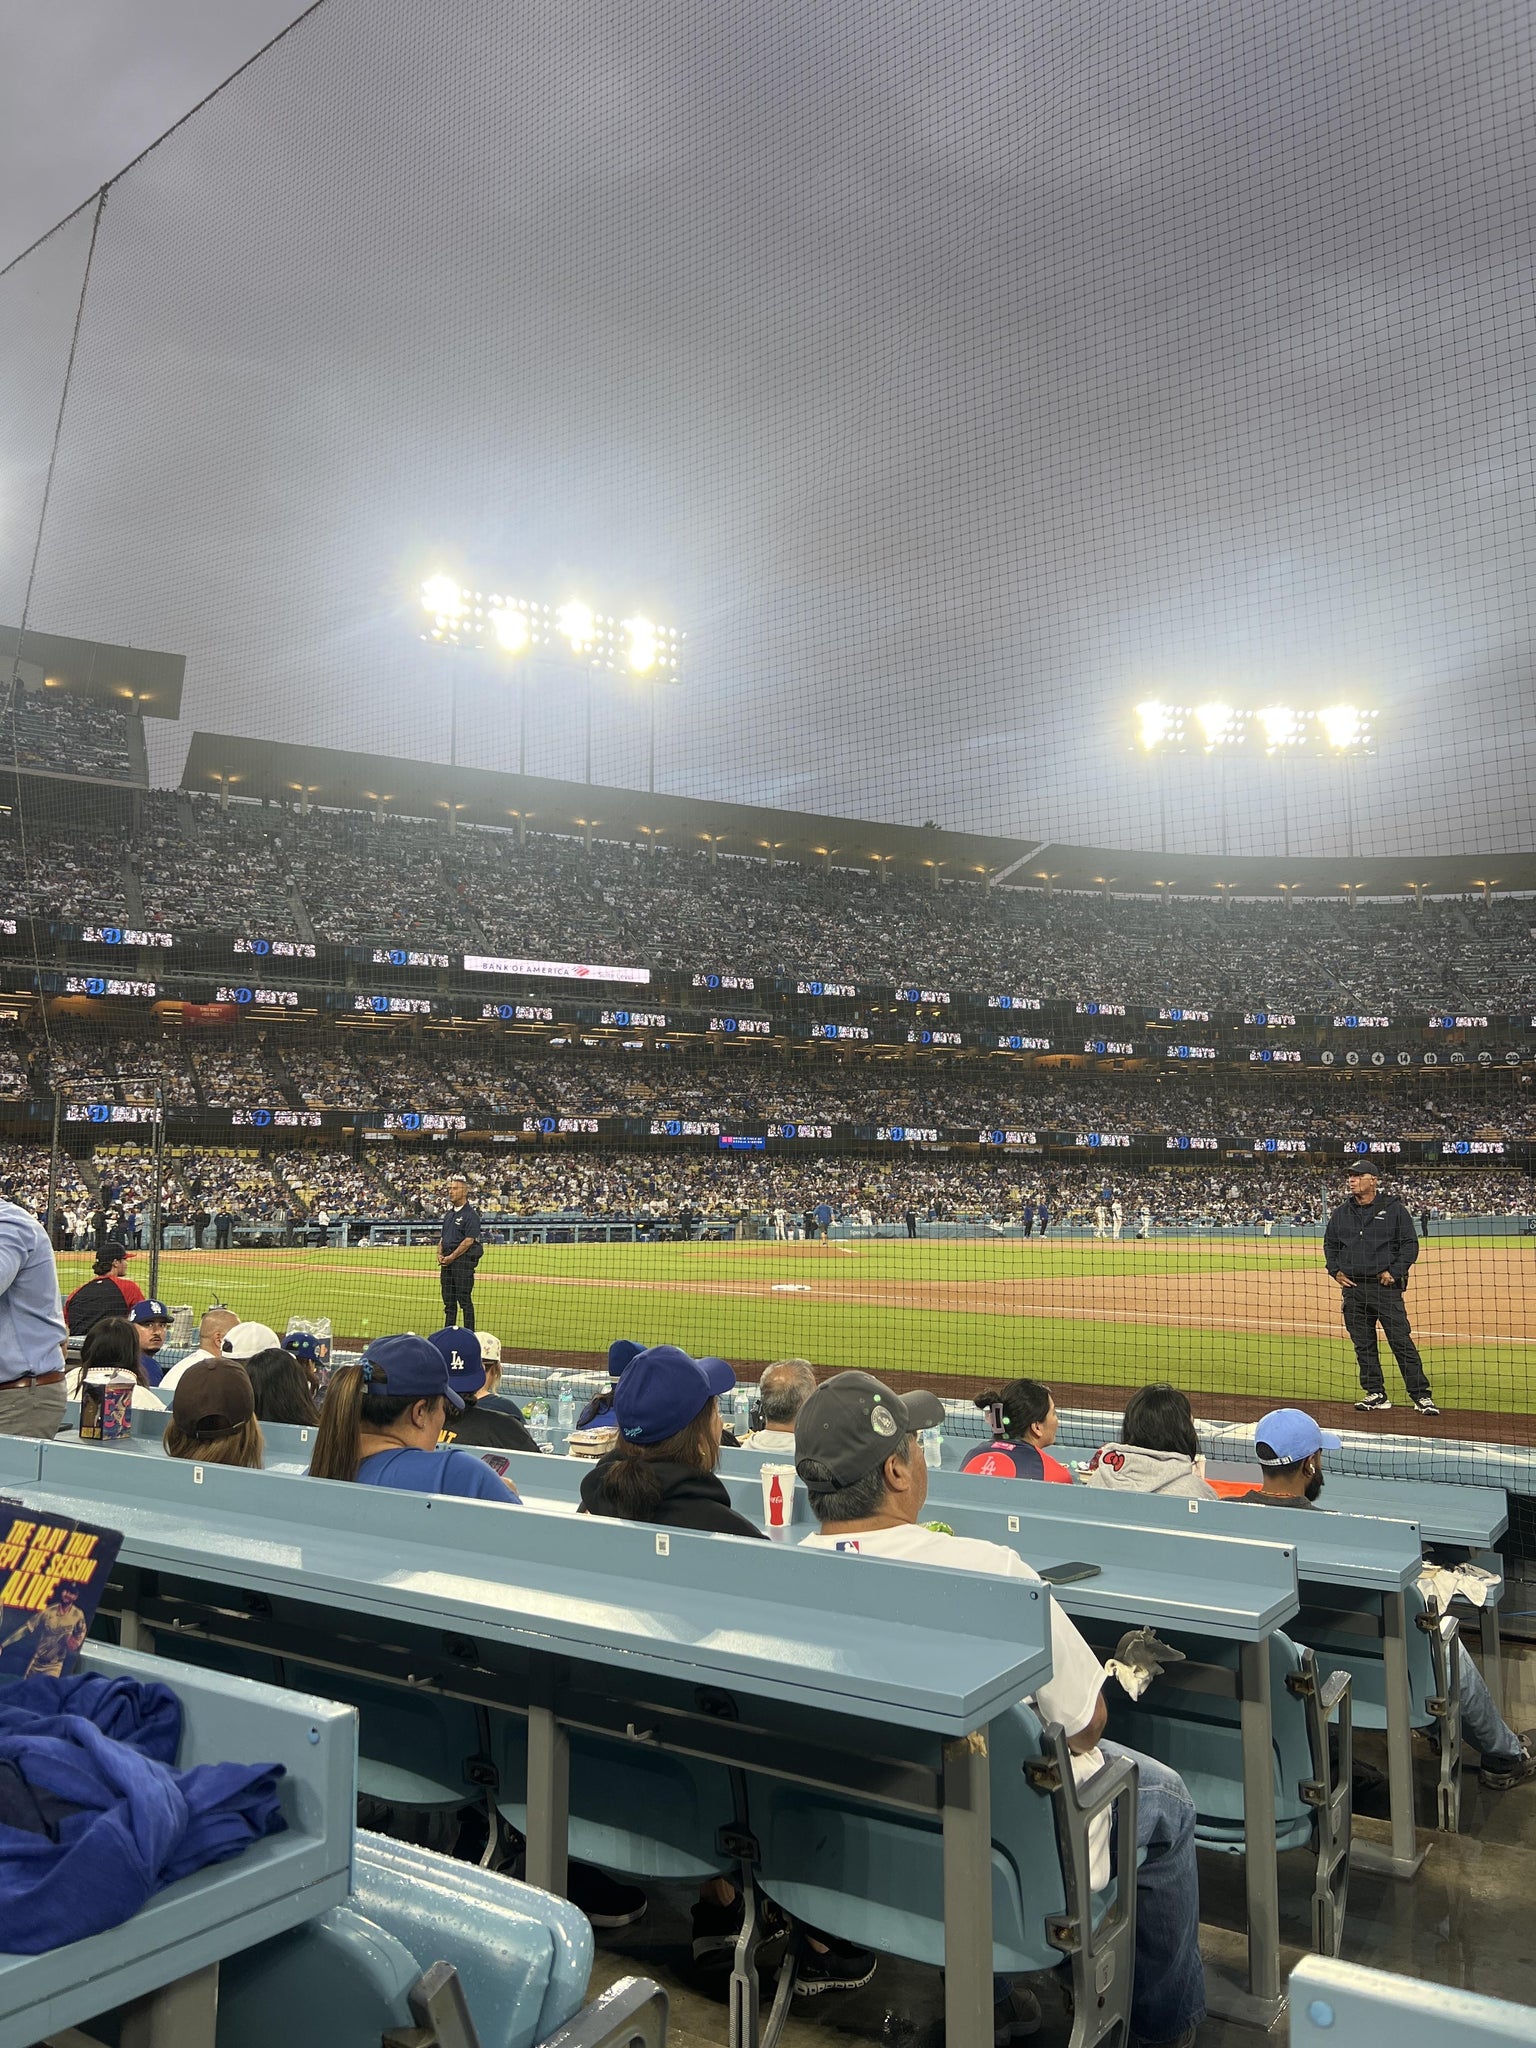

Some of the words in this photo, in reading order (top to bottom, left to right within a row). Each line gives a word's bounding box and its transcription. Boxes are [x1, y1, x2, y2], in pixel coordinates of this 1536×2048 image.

[482, 962, 509, 970] BANK
[512, 964, 524, 972] OF
[526, 966, 570, 976] AMERICA
[450, 1350, 465, 1370] LA
[980, 1455, 997, 1476] LA
[5, 1519, 37, 1546] THE
[31, 1525, 69, 1553] PLAY
[64, 1532, 99, 1558] THAT
[0, 1542, 26, 1570] EPT
[21, 1548, 51, 1573] THE
[45, 1553, 98, 1583] SEASON
[0, 1570, 61, 1611] ALIVE
